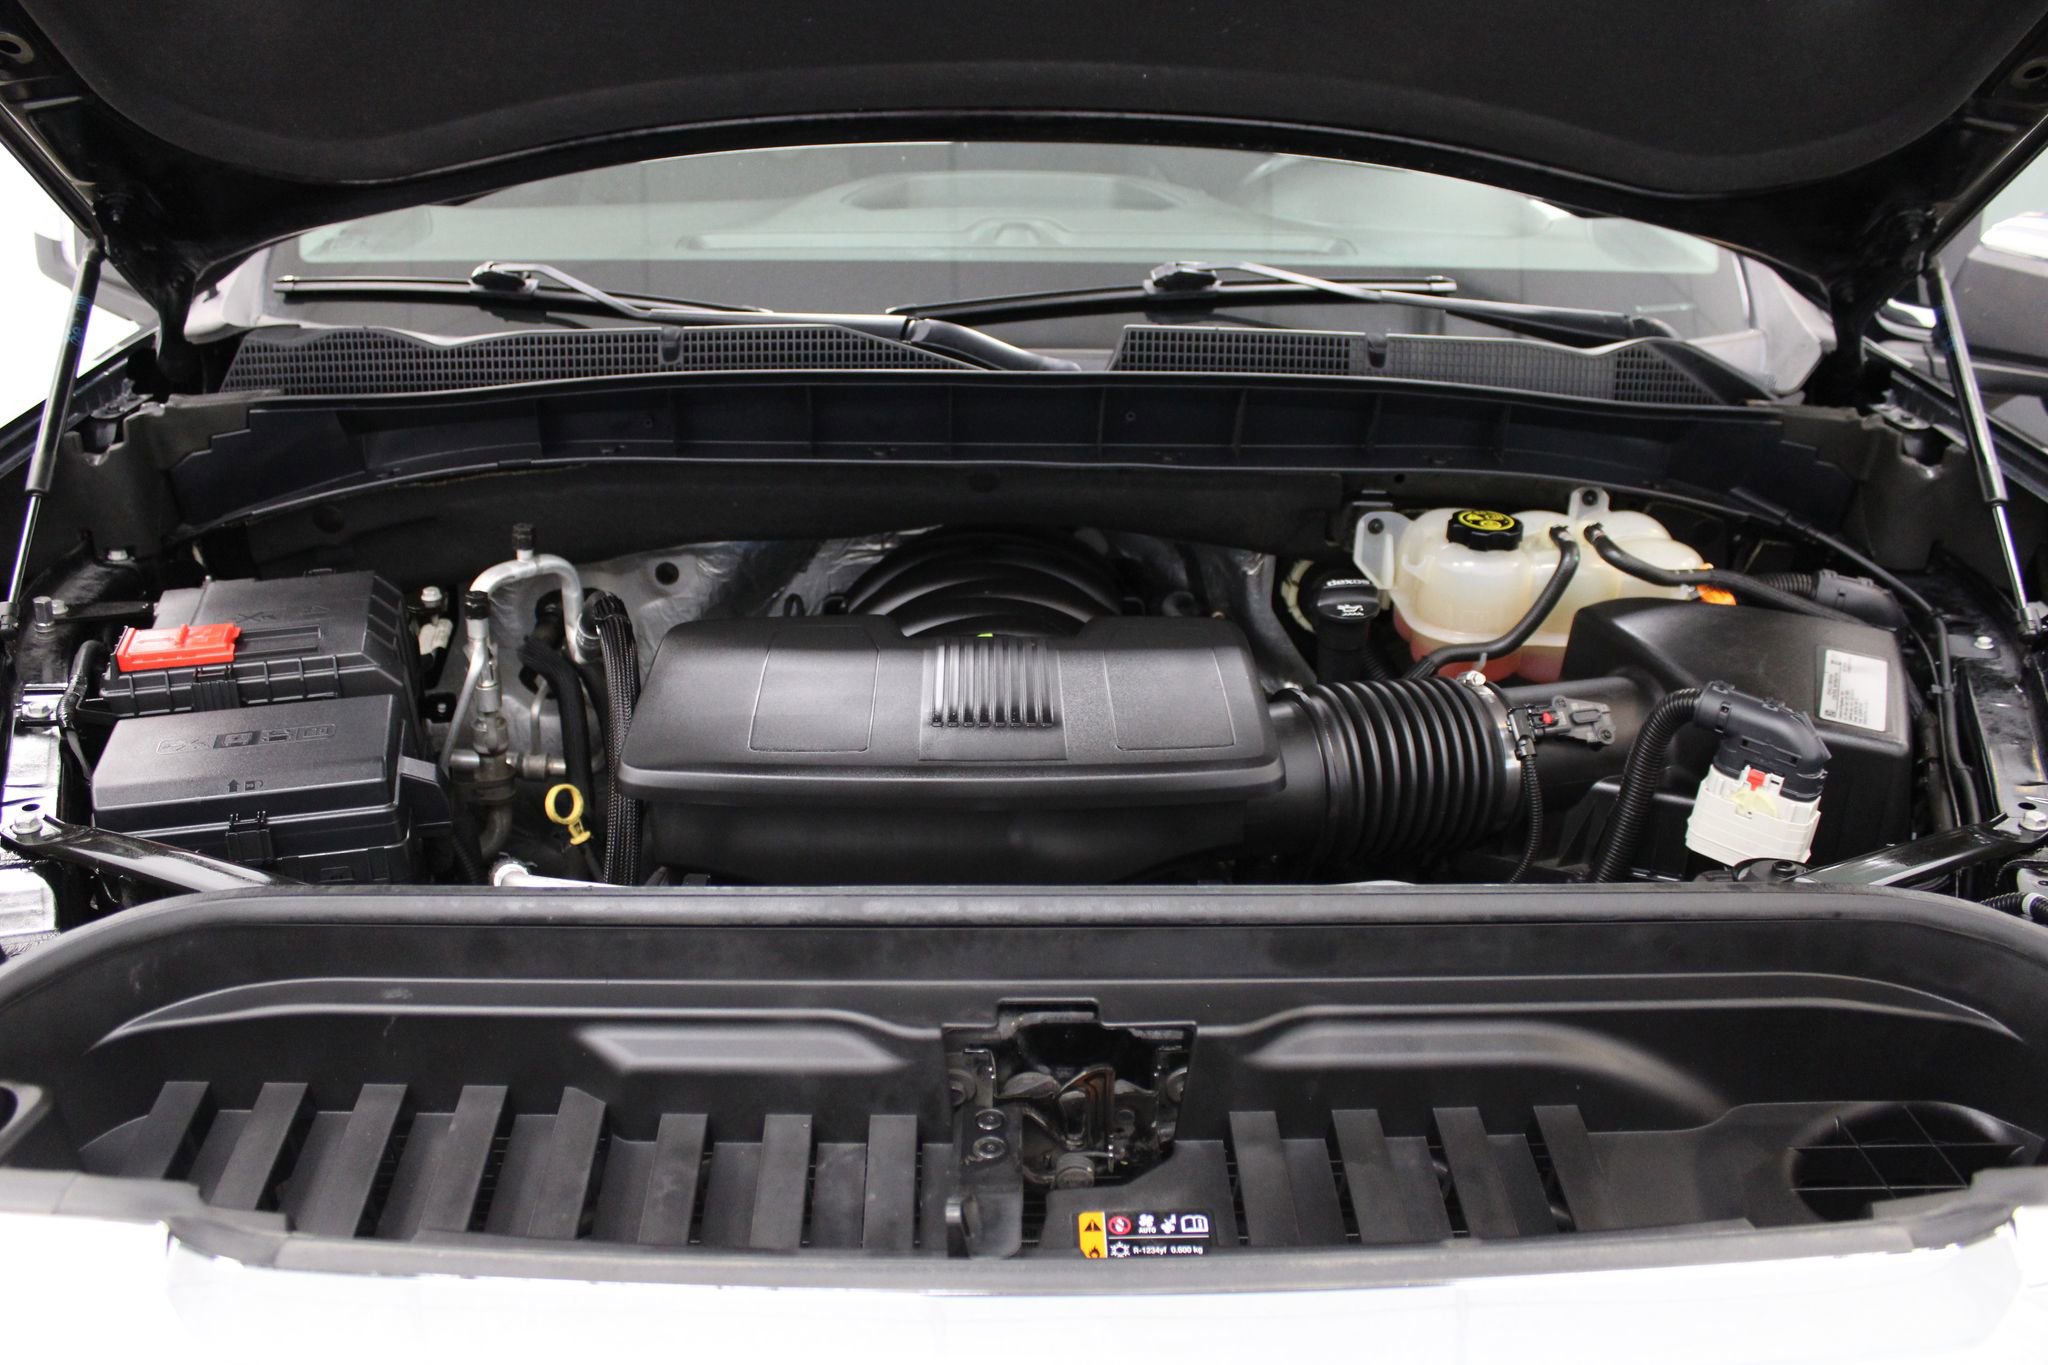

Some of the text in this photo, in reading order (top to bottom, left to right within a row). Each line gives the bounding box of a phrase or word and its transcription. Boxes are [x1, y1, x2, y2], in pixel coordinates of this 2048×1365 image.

[1138, 1226, 1156, 1234] AUTO
[1132, 1245, 1167, 1256] R-1234yf
[1192, 1245, 1203, 1255] kg
